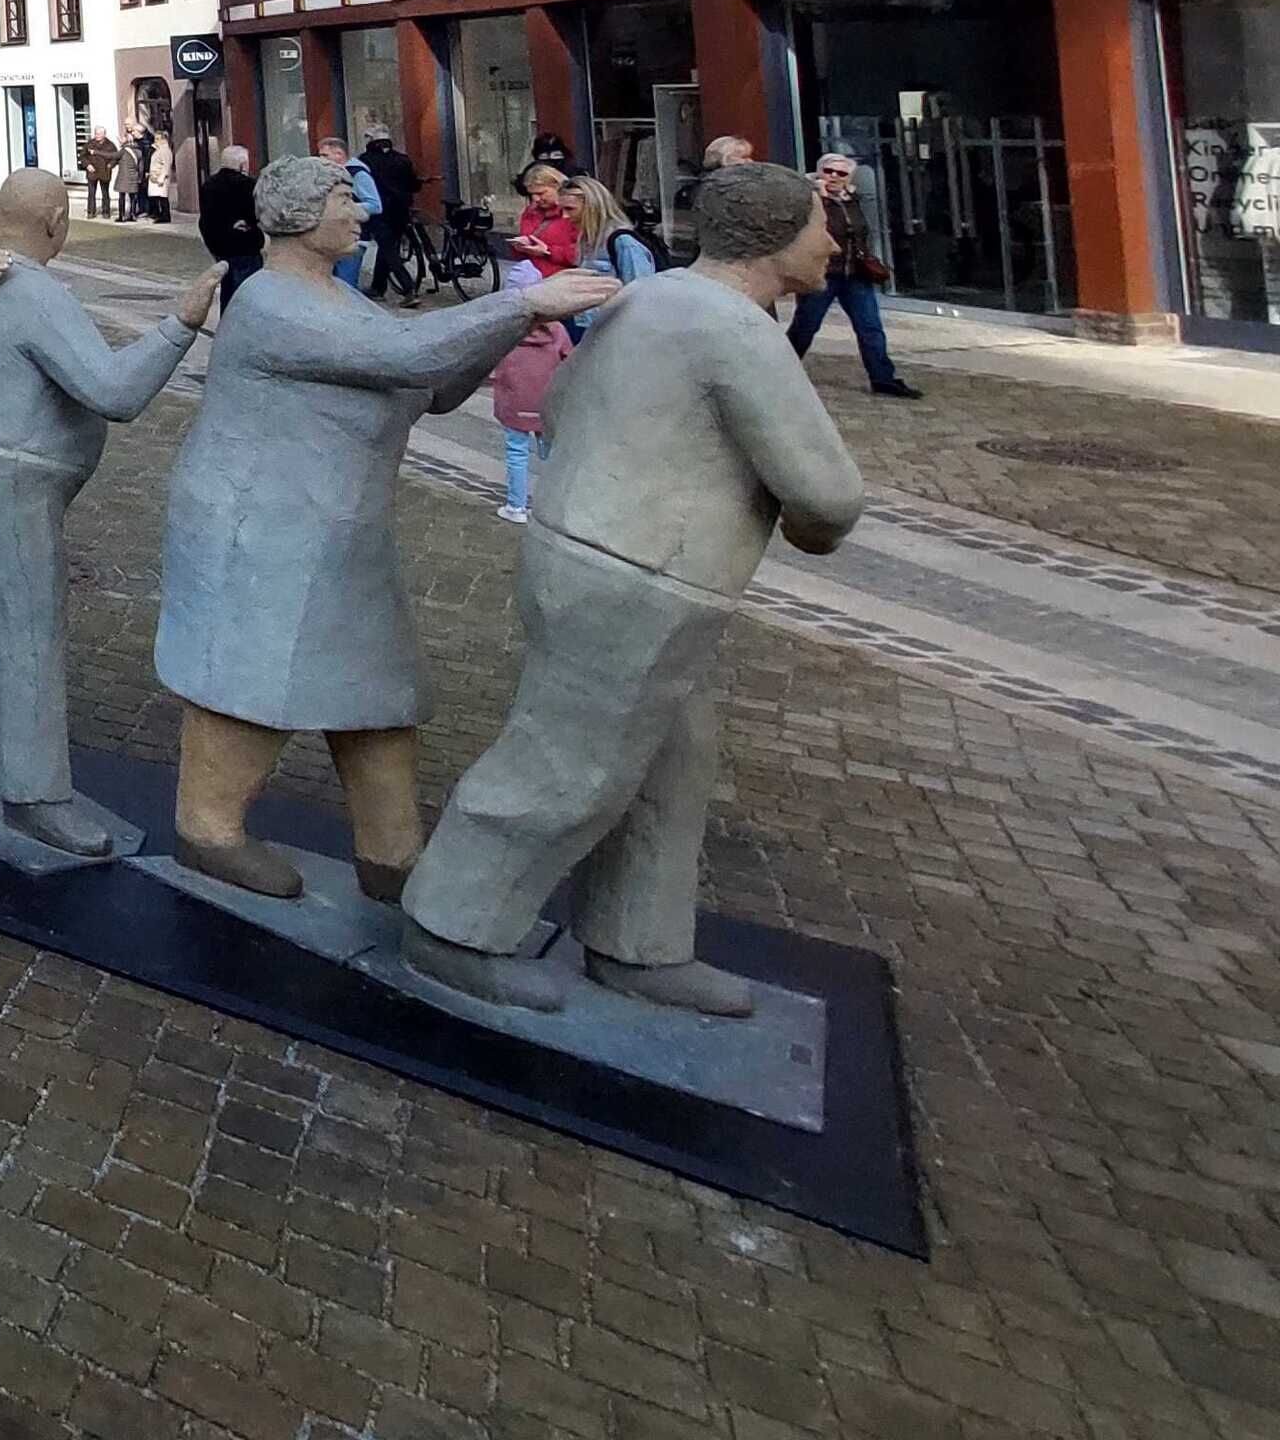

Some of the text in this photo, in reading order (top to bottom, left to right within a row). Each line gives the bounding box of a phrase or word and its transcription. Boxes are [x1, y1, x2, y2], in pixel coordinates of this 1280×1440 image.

[182, 51, 213, 61] KIND
[1189, 165, 1280, 184] Onne-
[1191, 191, 1280, 213] Rycli
